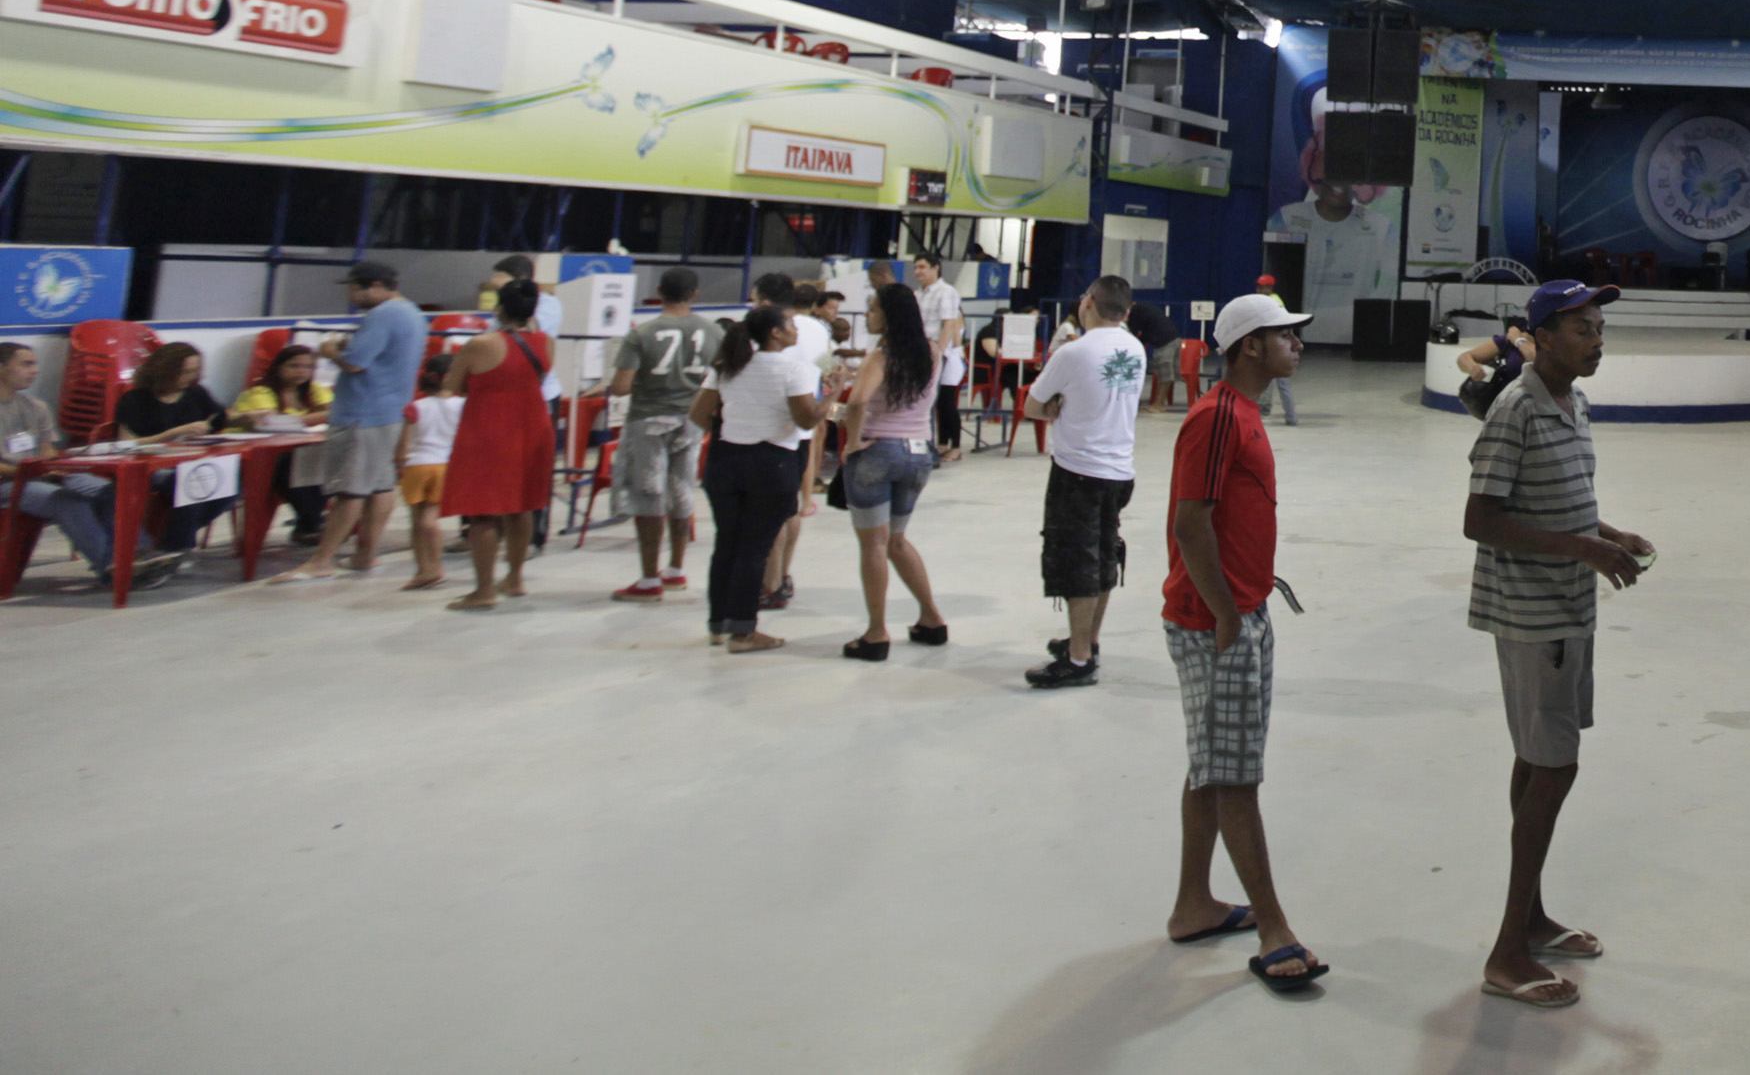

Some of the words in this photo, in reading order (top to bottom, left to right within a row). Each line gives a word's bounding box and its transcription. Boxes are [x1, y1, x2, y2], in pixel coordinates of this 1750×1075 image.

[238, 0, 329, 38] FRIO
[785, 144, 854, 175] ITAIPAVA
[650, 328, 706, 375] 71
